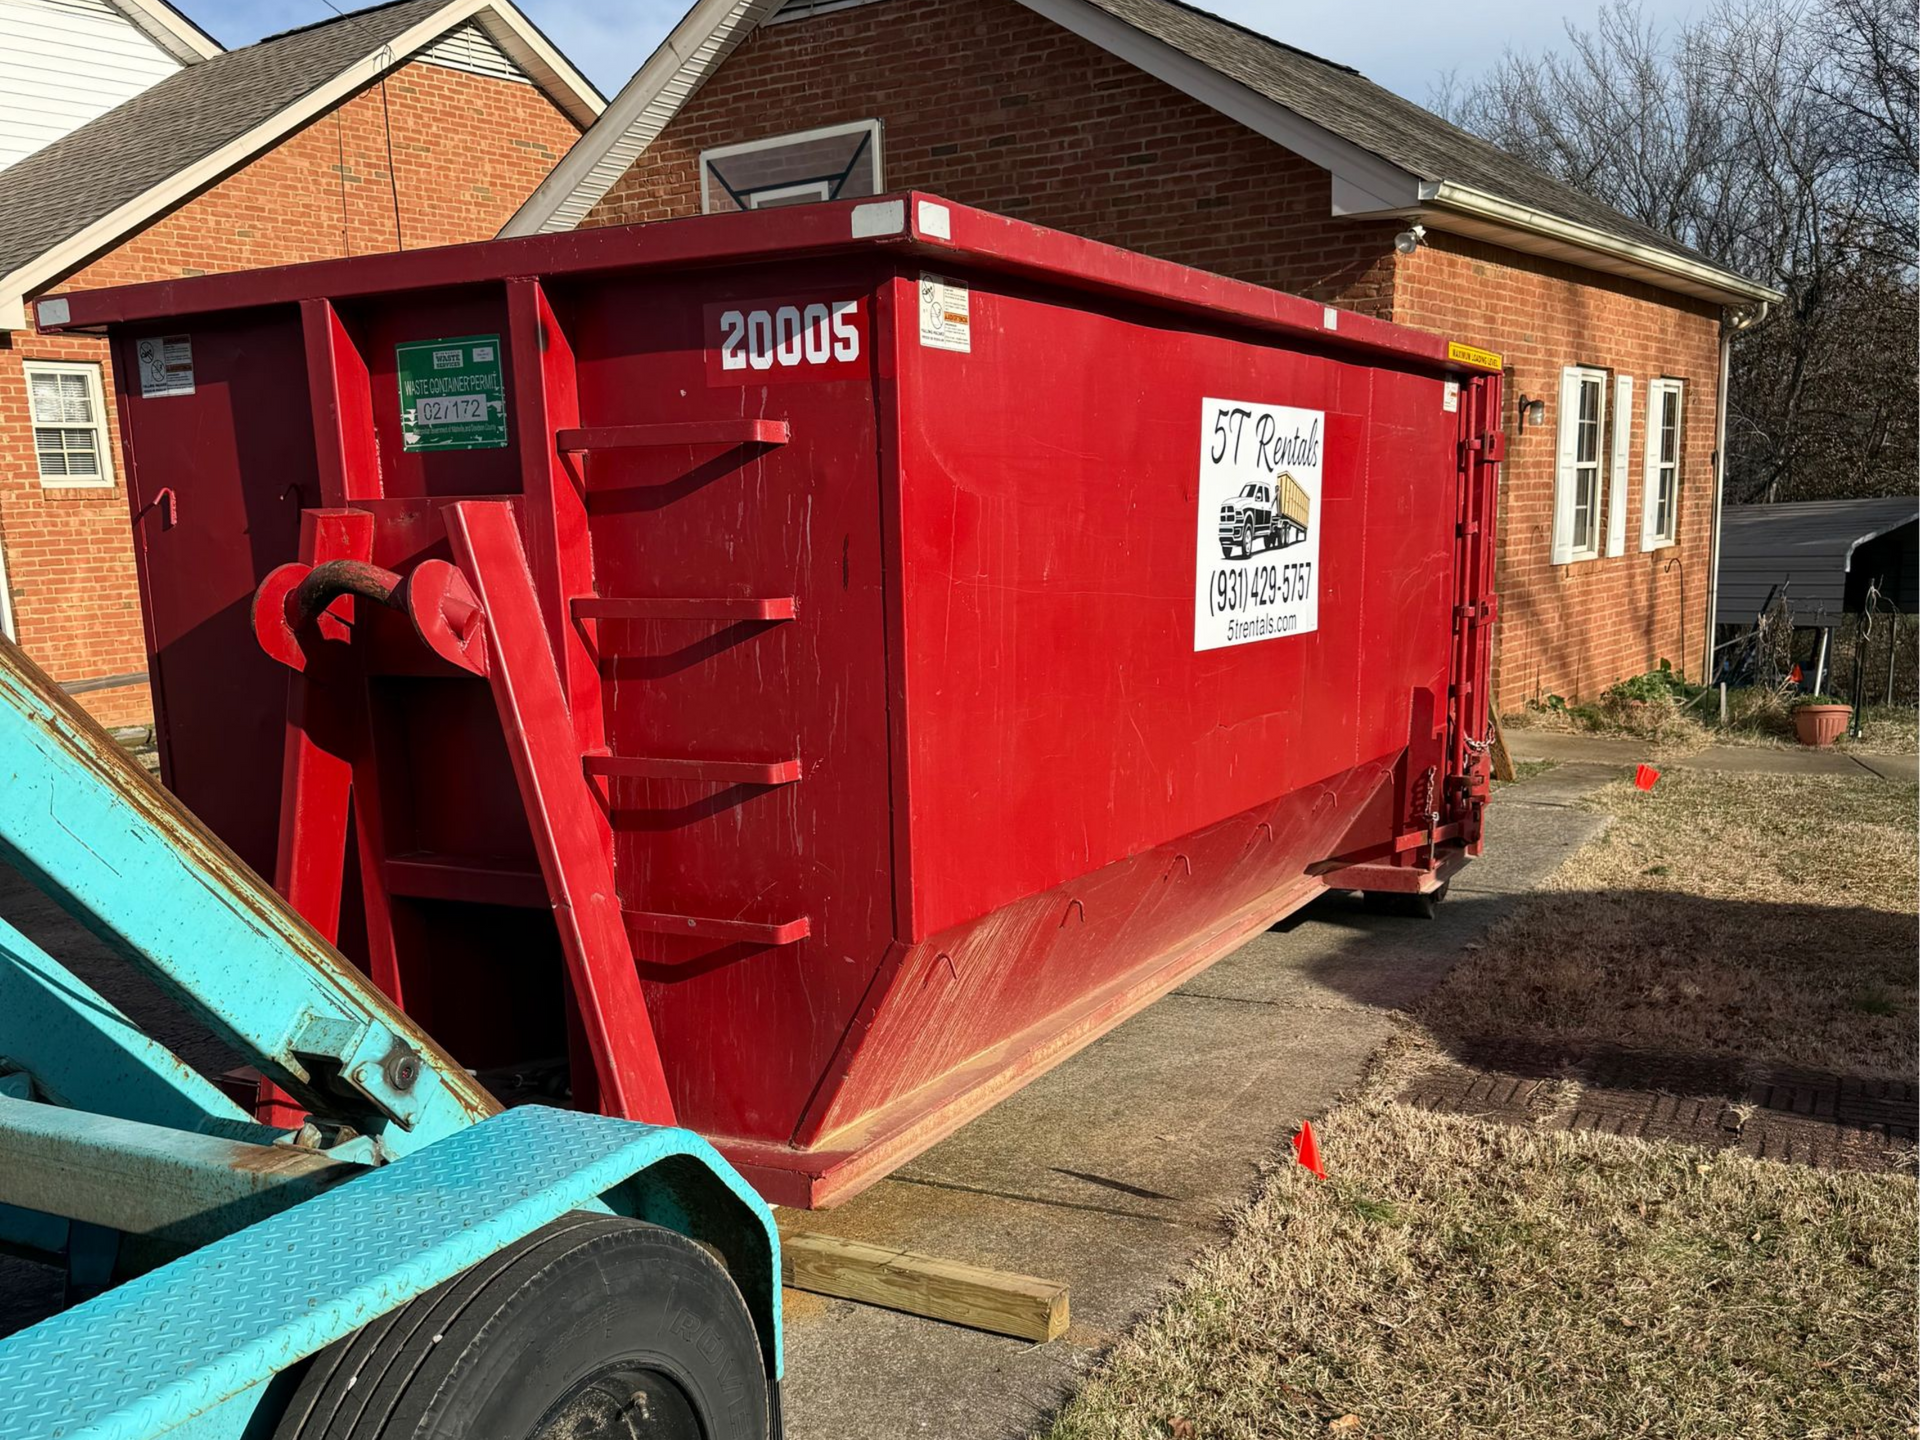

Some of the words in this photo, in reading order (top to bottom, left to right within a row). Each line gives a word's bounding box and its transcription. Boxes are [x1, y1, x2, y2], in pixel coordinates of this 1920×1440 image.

[720, 300, 860, 370] 20005
[435, 354, 460, 362] WASTE
[404, 379, 429, 396] WASTE
[429, 377, 470, 393] CONTAINER
[471, 374, 497, 390] PERMIT
[423, 399, 481, 421] 02/172
[1211, 408, 1252, 465] 5T
[1255, 413, 1319, 473] Rentals
[1227, 613, 1297, 641] 5trentals.com
